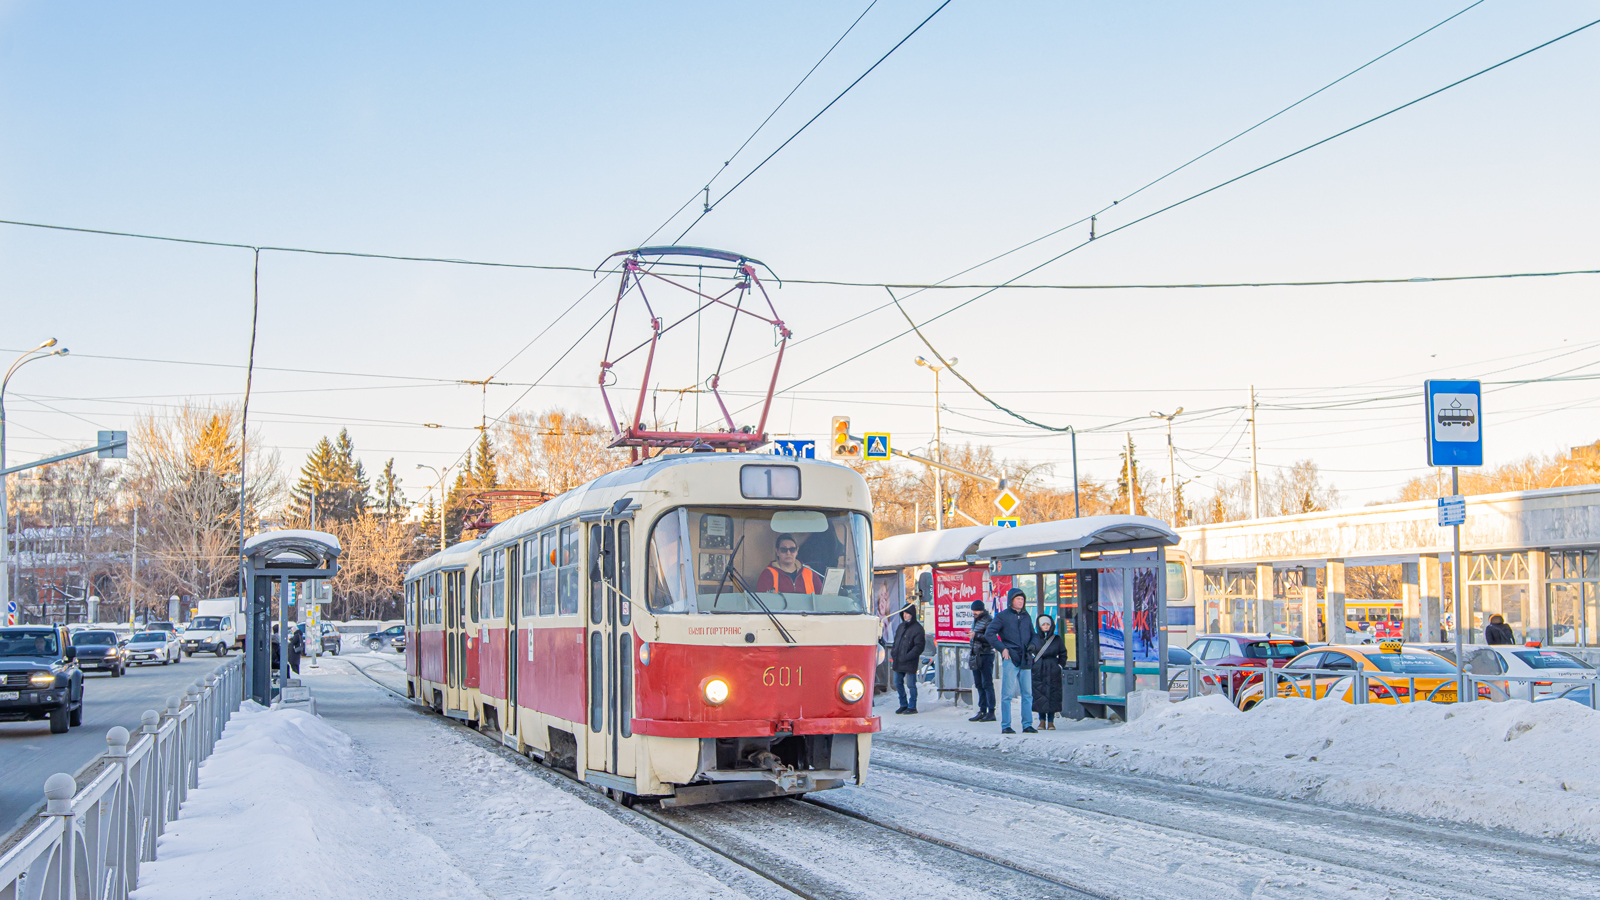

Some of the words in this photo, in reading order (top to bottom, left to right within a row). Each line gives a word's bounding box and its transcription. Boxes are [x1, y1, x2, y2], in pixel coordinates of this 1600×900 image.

[764, 469, 772, 497] 1
[762, 666, 802, 687] 601
[1440, 693, 1453, 701] 755
